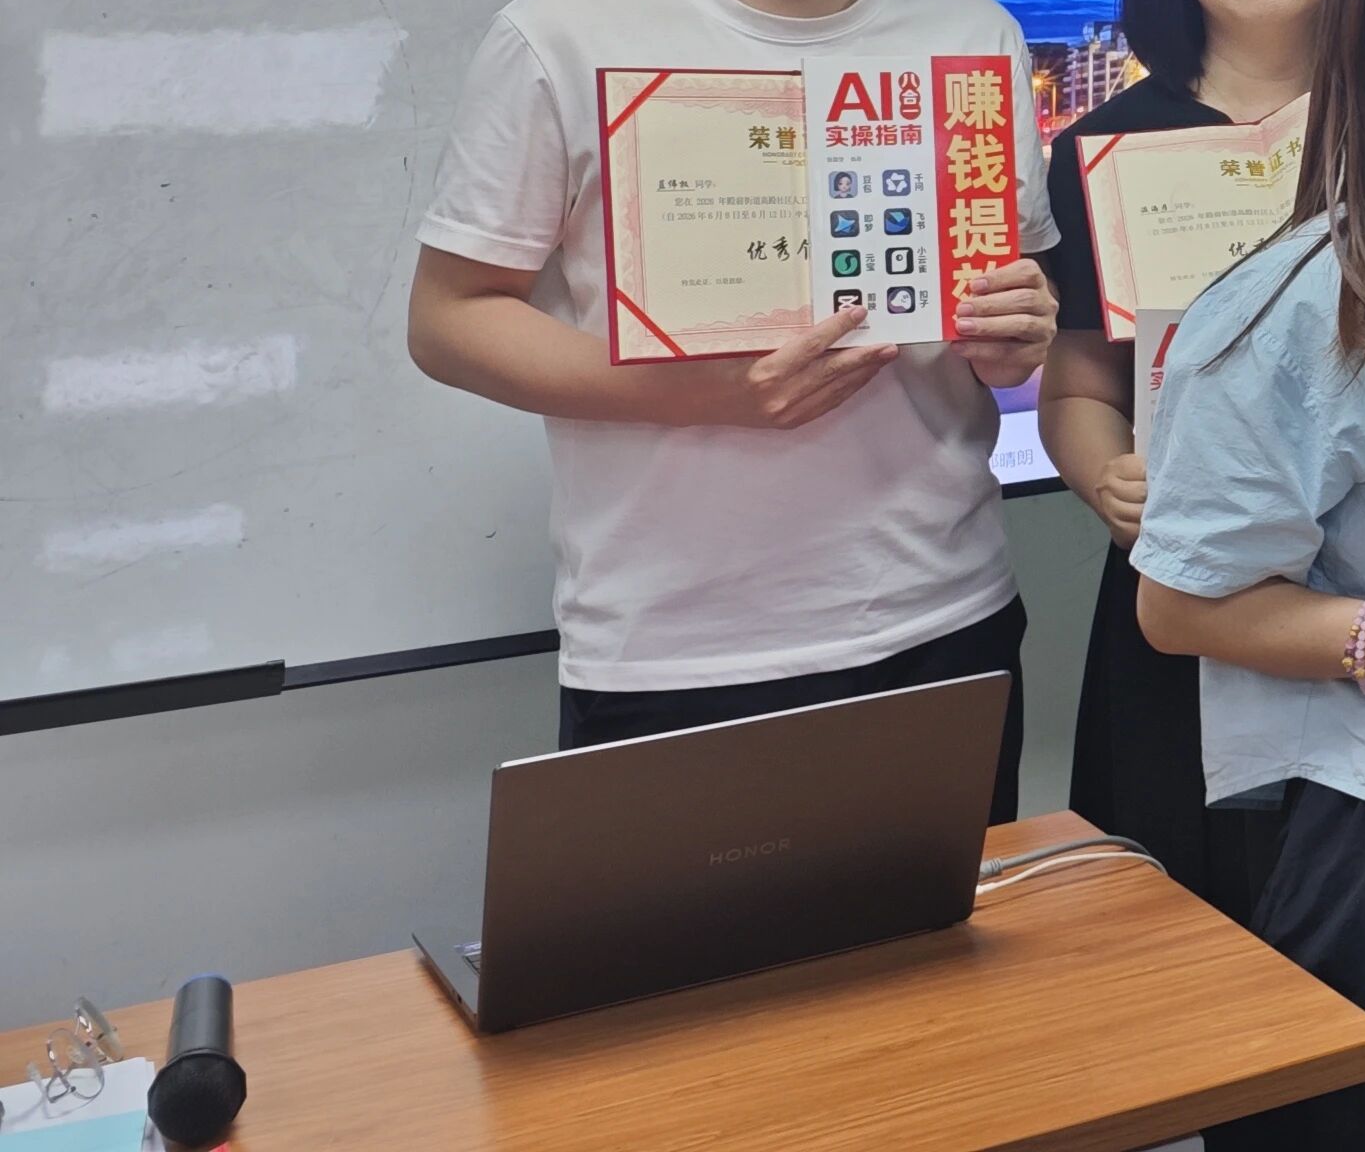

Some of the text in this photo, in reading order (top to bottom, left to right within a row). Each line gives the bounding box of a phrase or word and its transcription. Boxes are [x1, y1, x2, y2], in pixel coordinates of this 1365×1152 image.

[826, 71, 894, 122] AI
[900, 72, 921, 116] 八合一
[749, 126, 807, 150] 荣誉
[826, 124, 922, 148] 实操指南
[1219, 136, 1302, 178] 荣誉证书
[709, 838, 790, 866] HONOR
